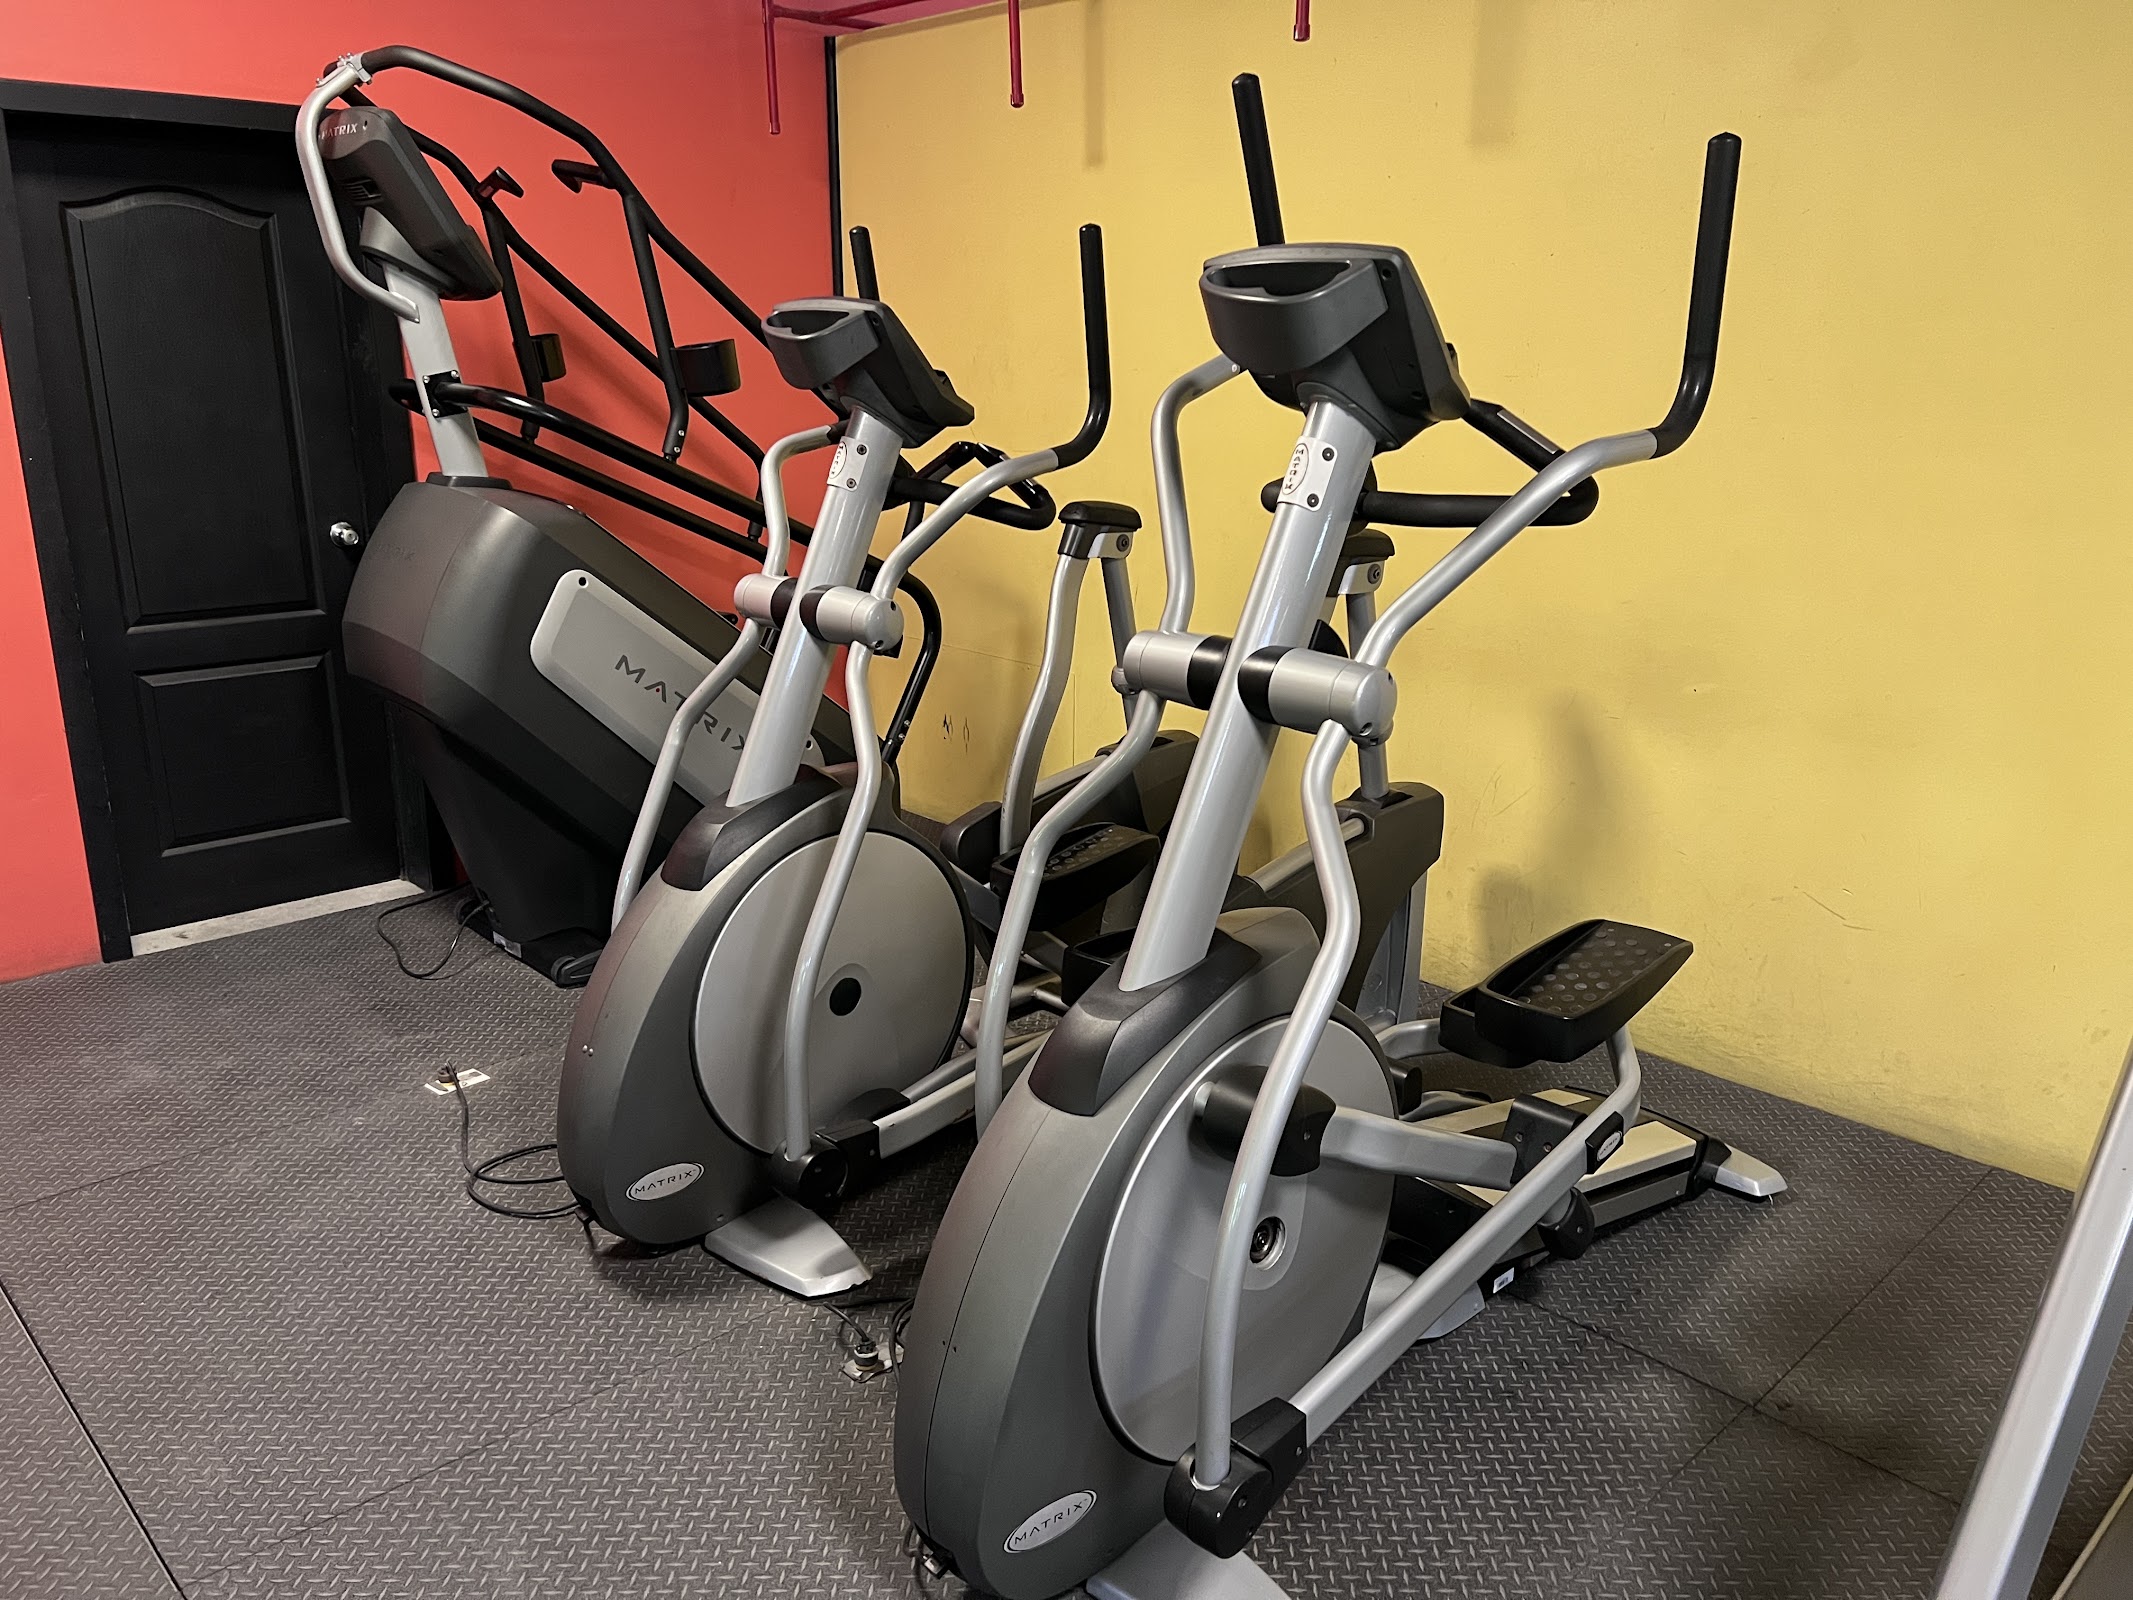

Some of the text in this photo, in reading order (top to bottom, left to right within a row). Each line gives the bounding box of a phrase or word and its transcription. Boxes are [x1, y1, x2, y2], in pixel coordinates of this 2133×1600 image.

[1284, 448, 1305, 490] MATRIX
[634, 1170, 693, 1194] MATRIX
[1014, 1501, 1083, 1545] MATRIX
